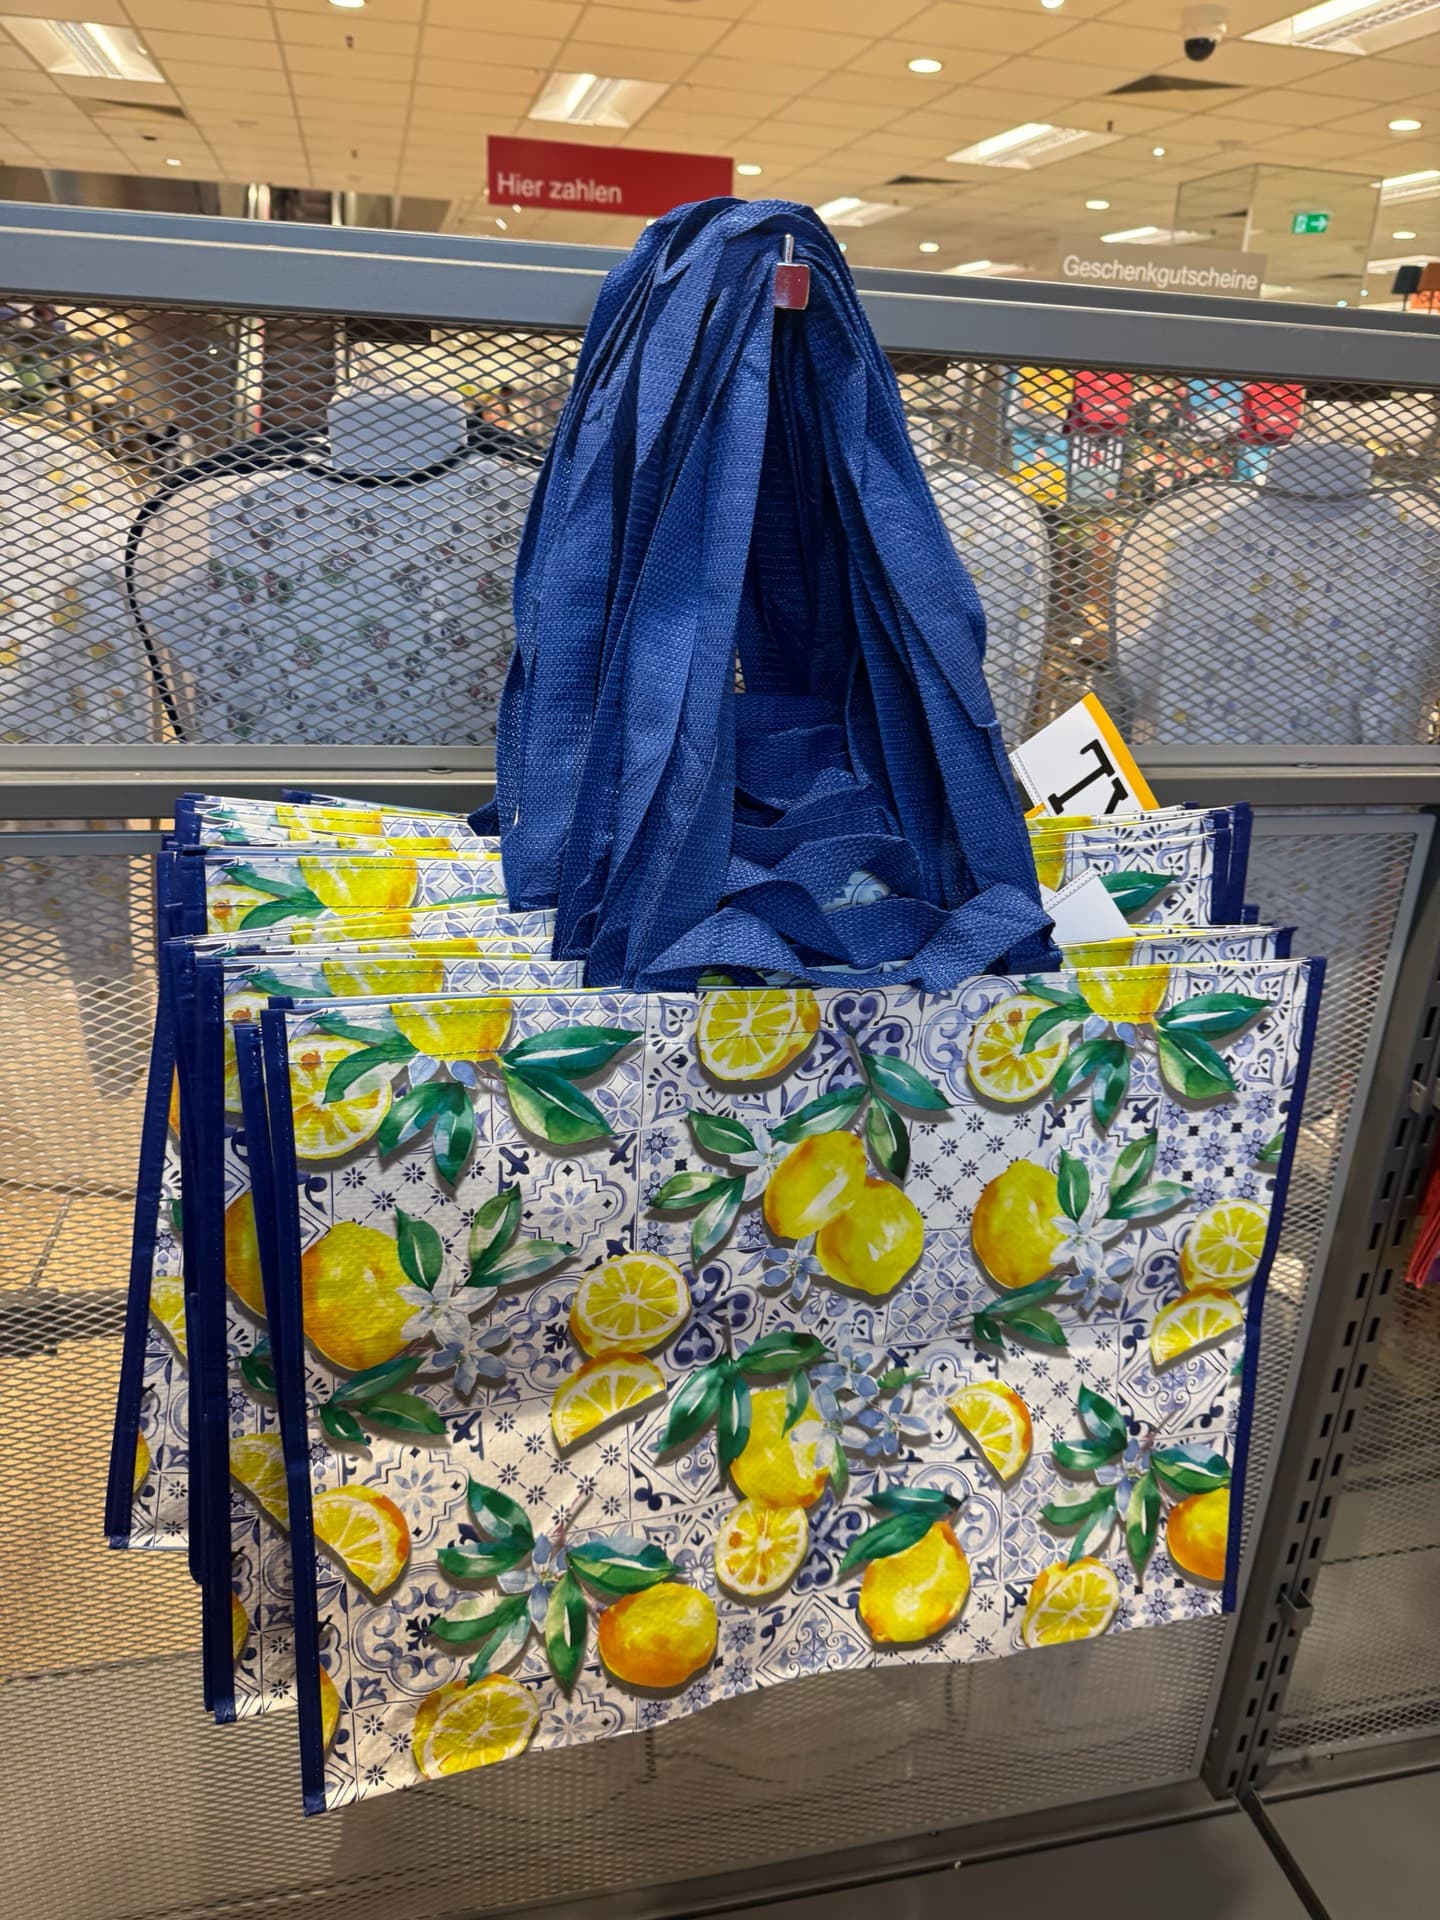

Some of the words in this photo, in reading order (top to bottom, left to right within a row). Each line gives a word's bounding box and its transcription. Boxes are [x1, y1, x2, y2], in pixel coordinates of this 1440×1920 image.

[497, 171, 544, 198] Hier
[548, 178, 623, 204] zahlen
[1062, 254, 1259, 291] Geschenkgutscheine
